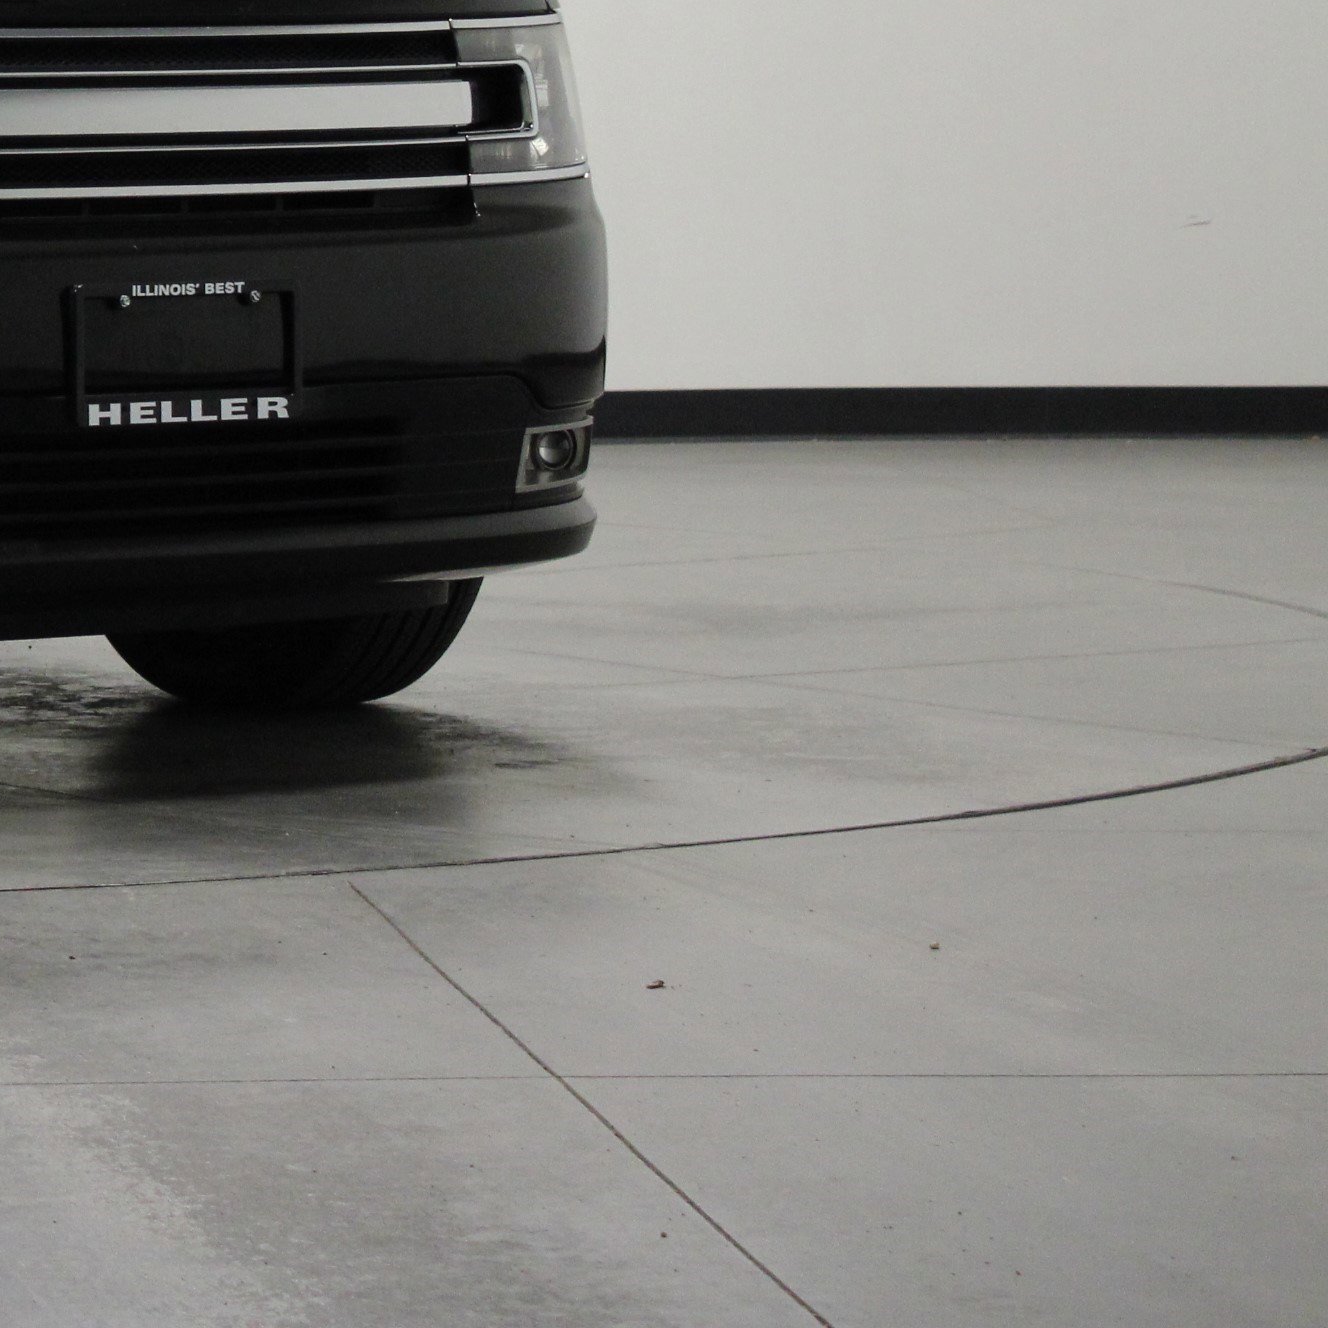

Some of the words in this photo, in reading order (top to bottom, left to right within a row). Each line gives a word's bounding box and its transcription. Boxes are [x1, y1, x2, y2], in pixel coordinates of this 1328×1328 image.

[131, 283, 201, 297] ILLINOIS'
[204, 281, 246, 295] BEST
[87, 396, 290, 426] HELLER
